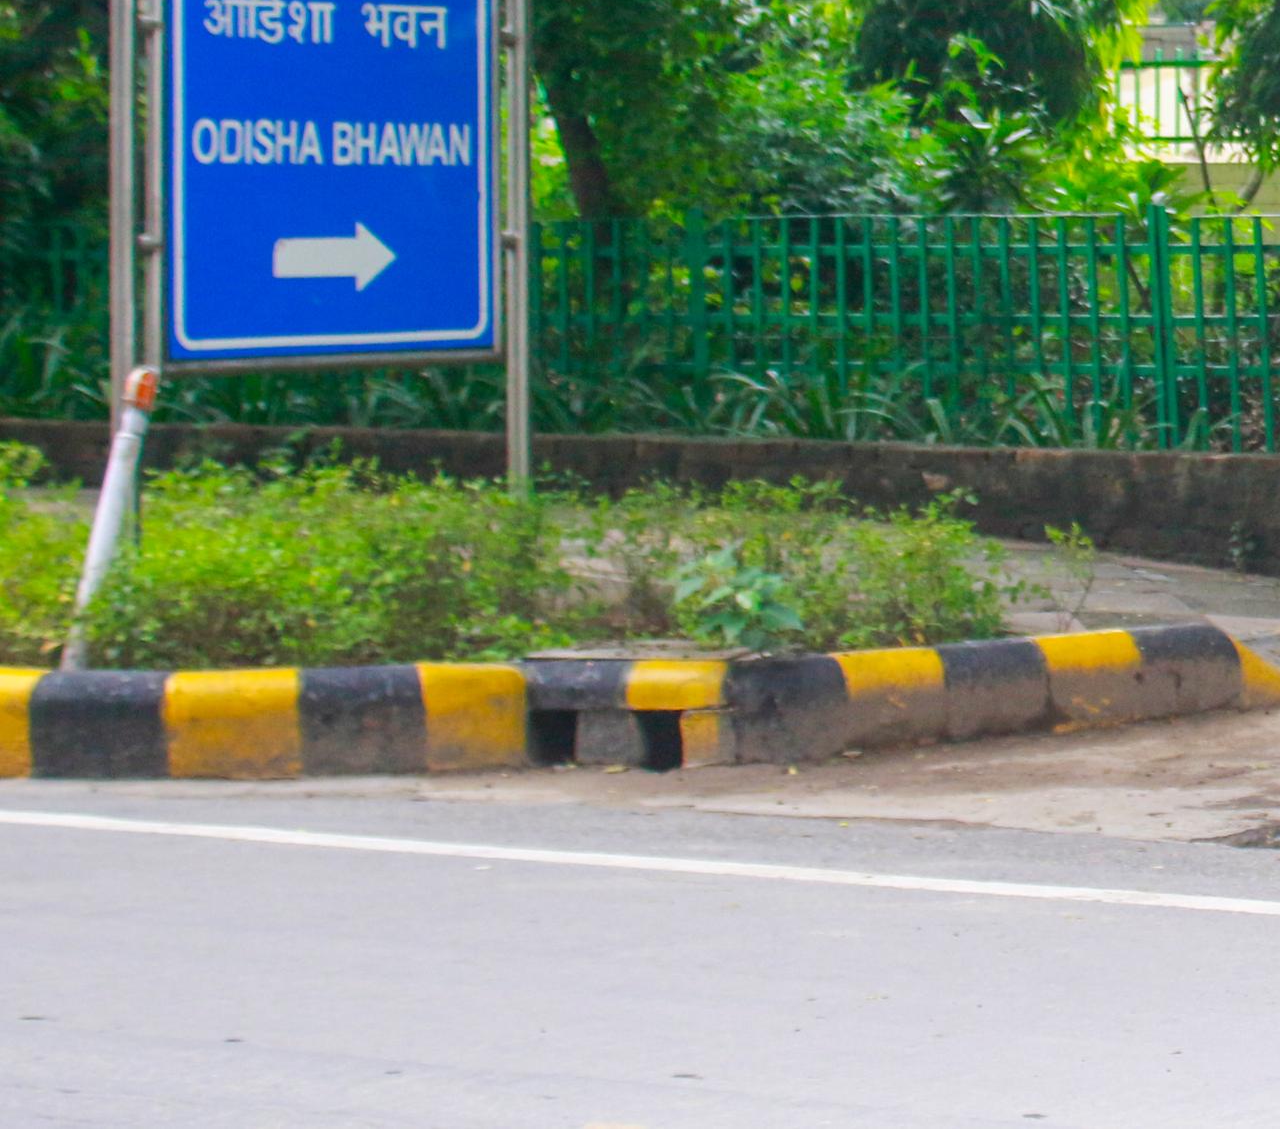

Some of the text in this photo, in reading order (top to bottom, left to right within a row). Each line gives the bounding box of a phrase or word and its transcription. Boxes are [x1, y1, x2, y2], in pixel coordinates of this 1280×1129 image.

[361, 2, 447, 50] भवन
[191, 117, 472, 167] ODISHA BHAWAN
